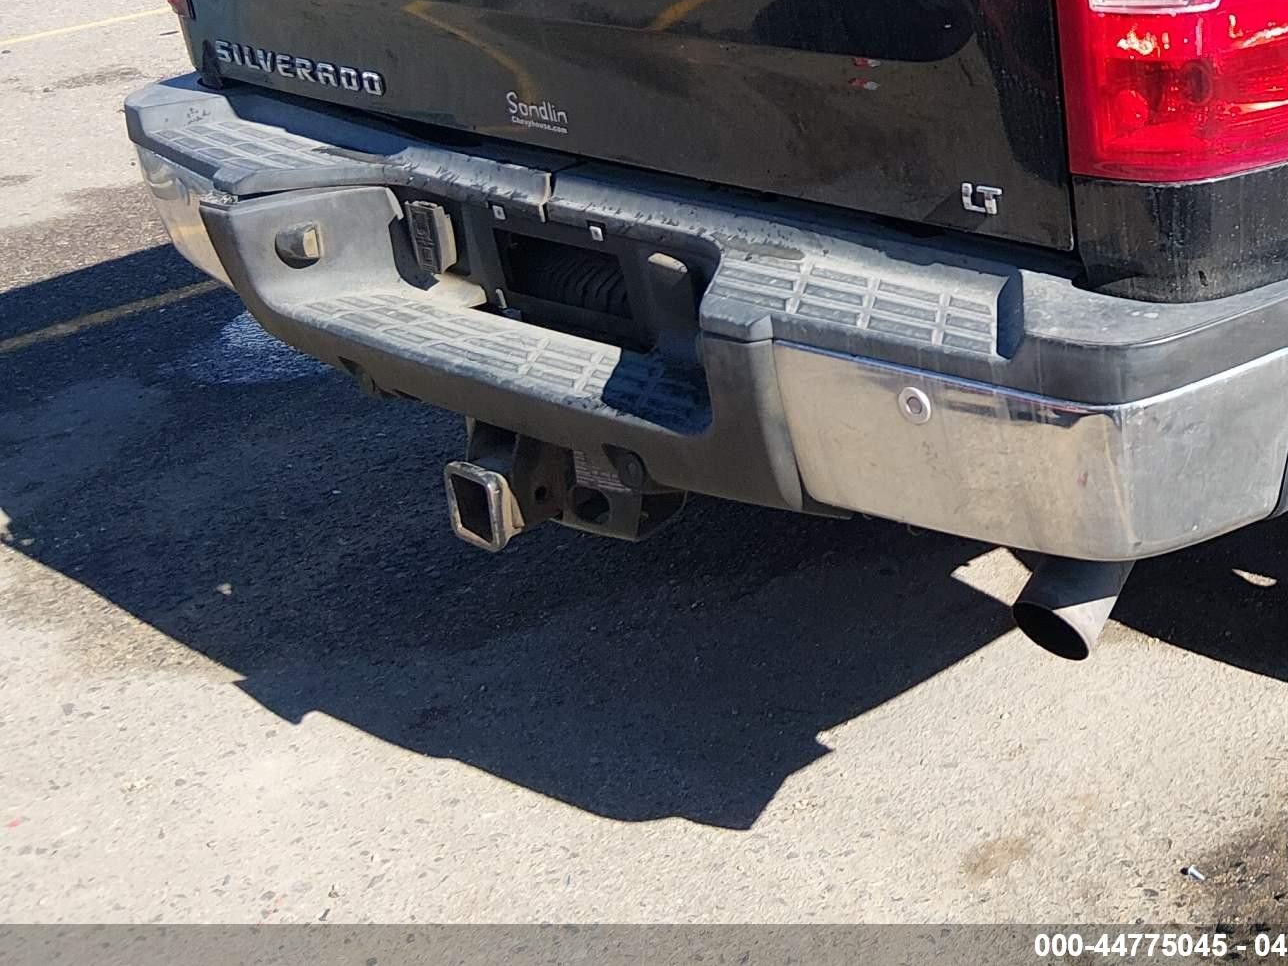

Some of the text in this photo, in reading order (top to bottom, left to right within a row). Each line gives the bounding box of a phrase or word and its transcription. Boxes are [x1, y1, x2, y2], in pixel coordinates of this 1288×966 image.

[215, 40, 384, 96] SILVERADO
[506, 91, 568, 124] Sandlin
[962, 182, 1002, 215] LT
